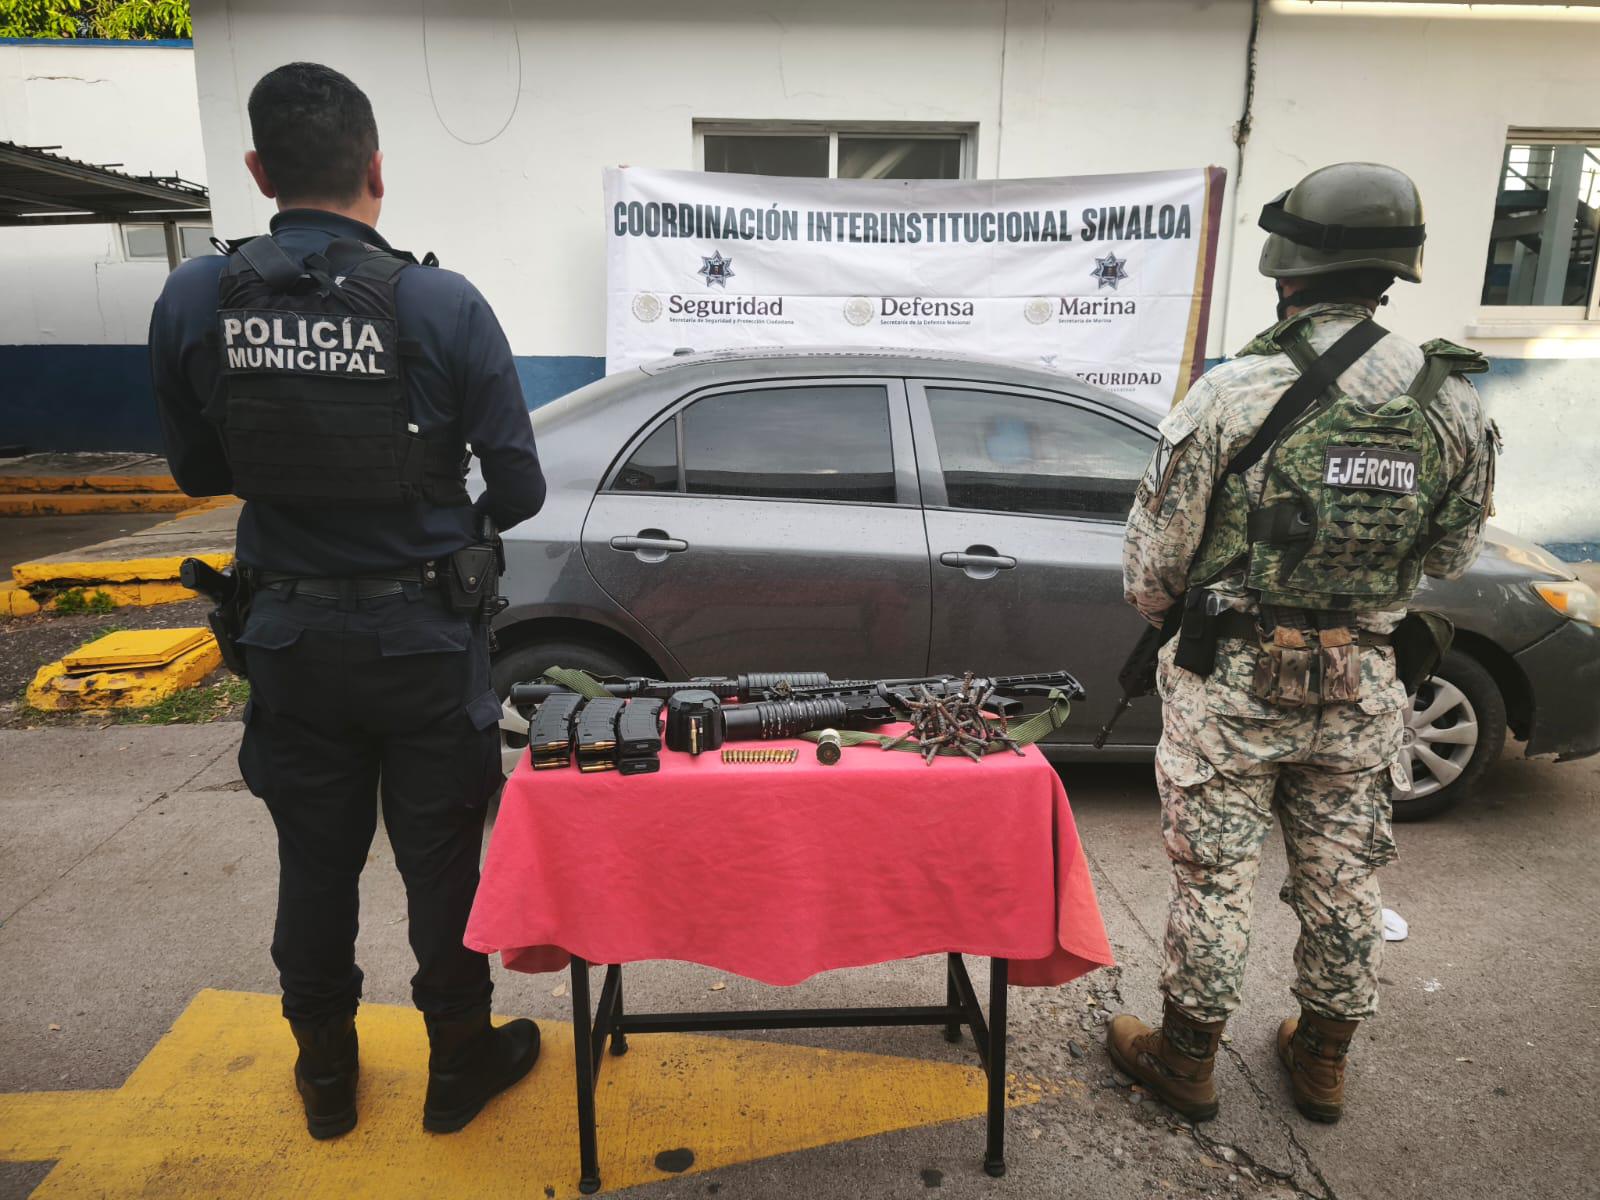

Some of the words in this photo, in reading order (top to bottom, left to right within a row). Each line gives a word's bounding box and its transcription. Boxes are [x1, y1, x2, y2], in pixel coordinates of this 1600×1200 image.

[614, 200, 798, 241] COORDINACIÓN
[807, 210, 1072, 243] INTERINSTITUCIONAL
[1080, 204, 1191, 241] SINALOA
[669, 294, 783, 318] Seguridad
[880, 296, 974, 317] Defensa
[1058, 296, 1136, 316] Marina
[223, 316, 385, 353] POLICÍA
[227, 347, 386, 375] MUNICIPAL
[1326, 450, 1415, 490] EJÉRCITO
